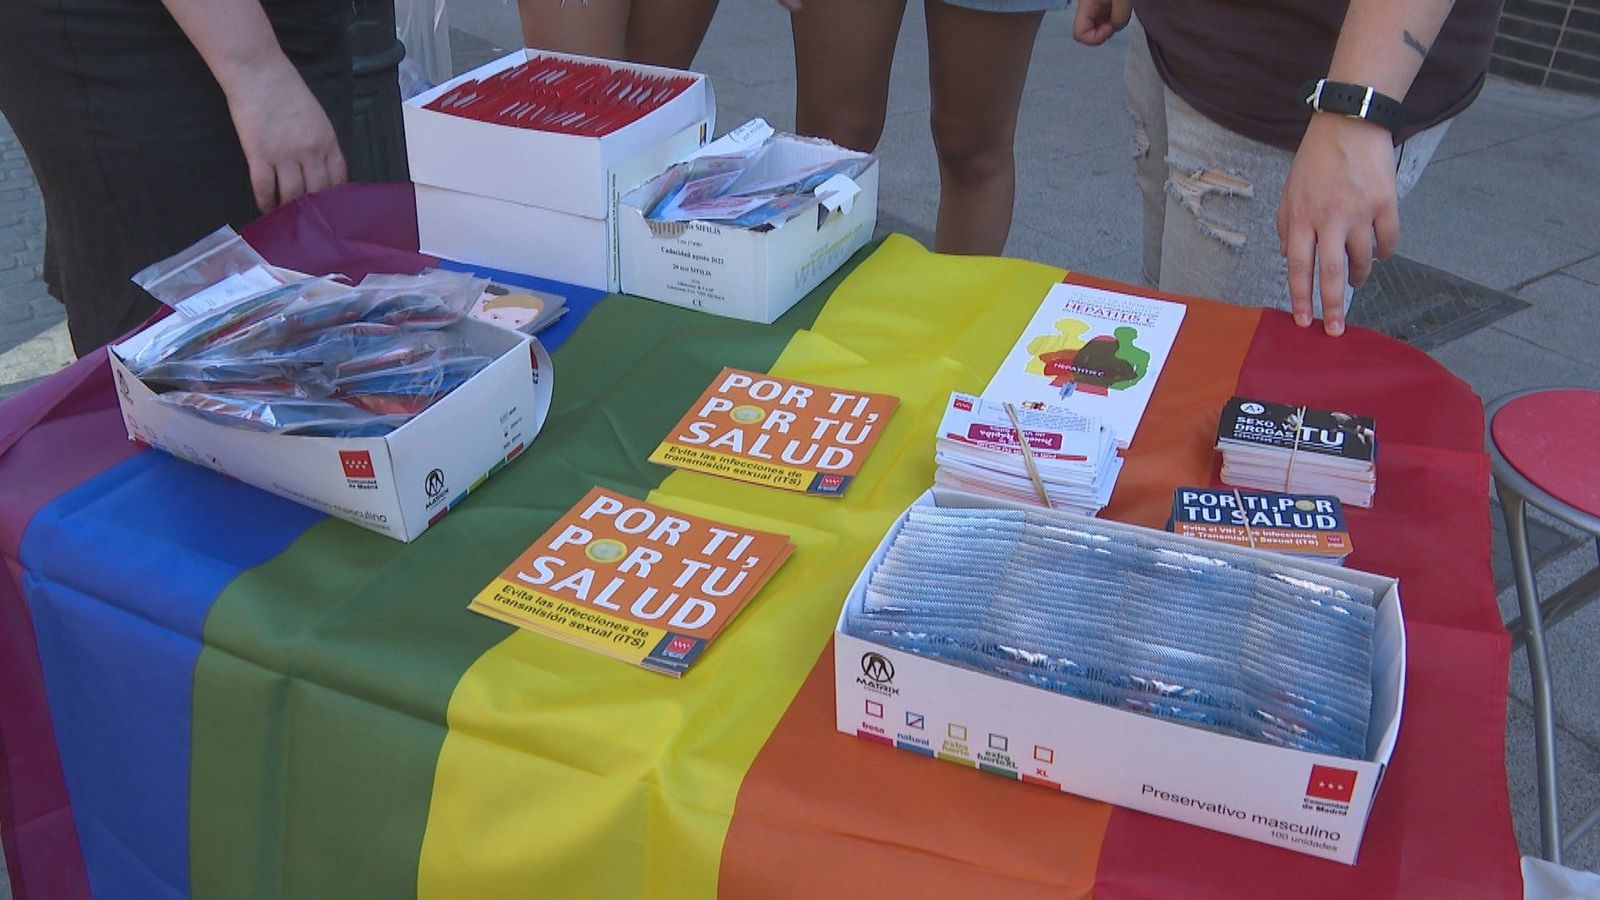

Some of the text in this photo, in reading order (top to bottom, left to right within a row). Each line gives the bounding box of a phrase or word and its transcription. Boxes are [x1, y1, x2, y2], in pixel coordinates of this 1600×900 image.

[661, 246, 691, 258] Caducidad
[1065, 302, 1141, 322] HEPATITIS
[718, 373, 879, 423] POR TI,
[1234, 423, 1295, 439] DROGAS
[678, 421, 854, 470] SALUD
[663, 453, 802, 486] transmisión sexual (ITS)
[669, 446, 803, 478] Evita las infecciones de
[1182, 491, 1235, 507] POR
[1184, 506, 1337, 530] TU SALUD
[579, 495, 760, 568] POR TI,
[1182, 524, 1207, 532] Evita
[1219, 527, 1236, 535] VIH
[516, 556, 717, 630] SALUD
[493, 593, 646, 649] transmisión sexual (ITS)
[501, 584, 649, 638] Evita las infecciones de
[856, 676, 901, 696] MATRIX
[862, 721, 885, 734] fresa
[897, 733, 930, 746] natural
[985, 751, 1011, 762] extra
[1036, 768, 1049, 777] XL
[1141, 783, 1341, 841] Preservativo masculino
[1303, 797, 1349, 810] Comunidad
[1315, 806, 1348, 816] Madrid
[1271, 830, 1338, 852] 100 unidades
